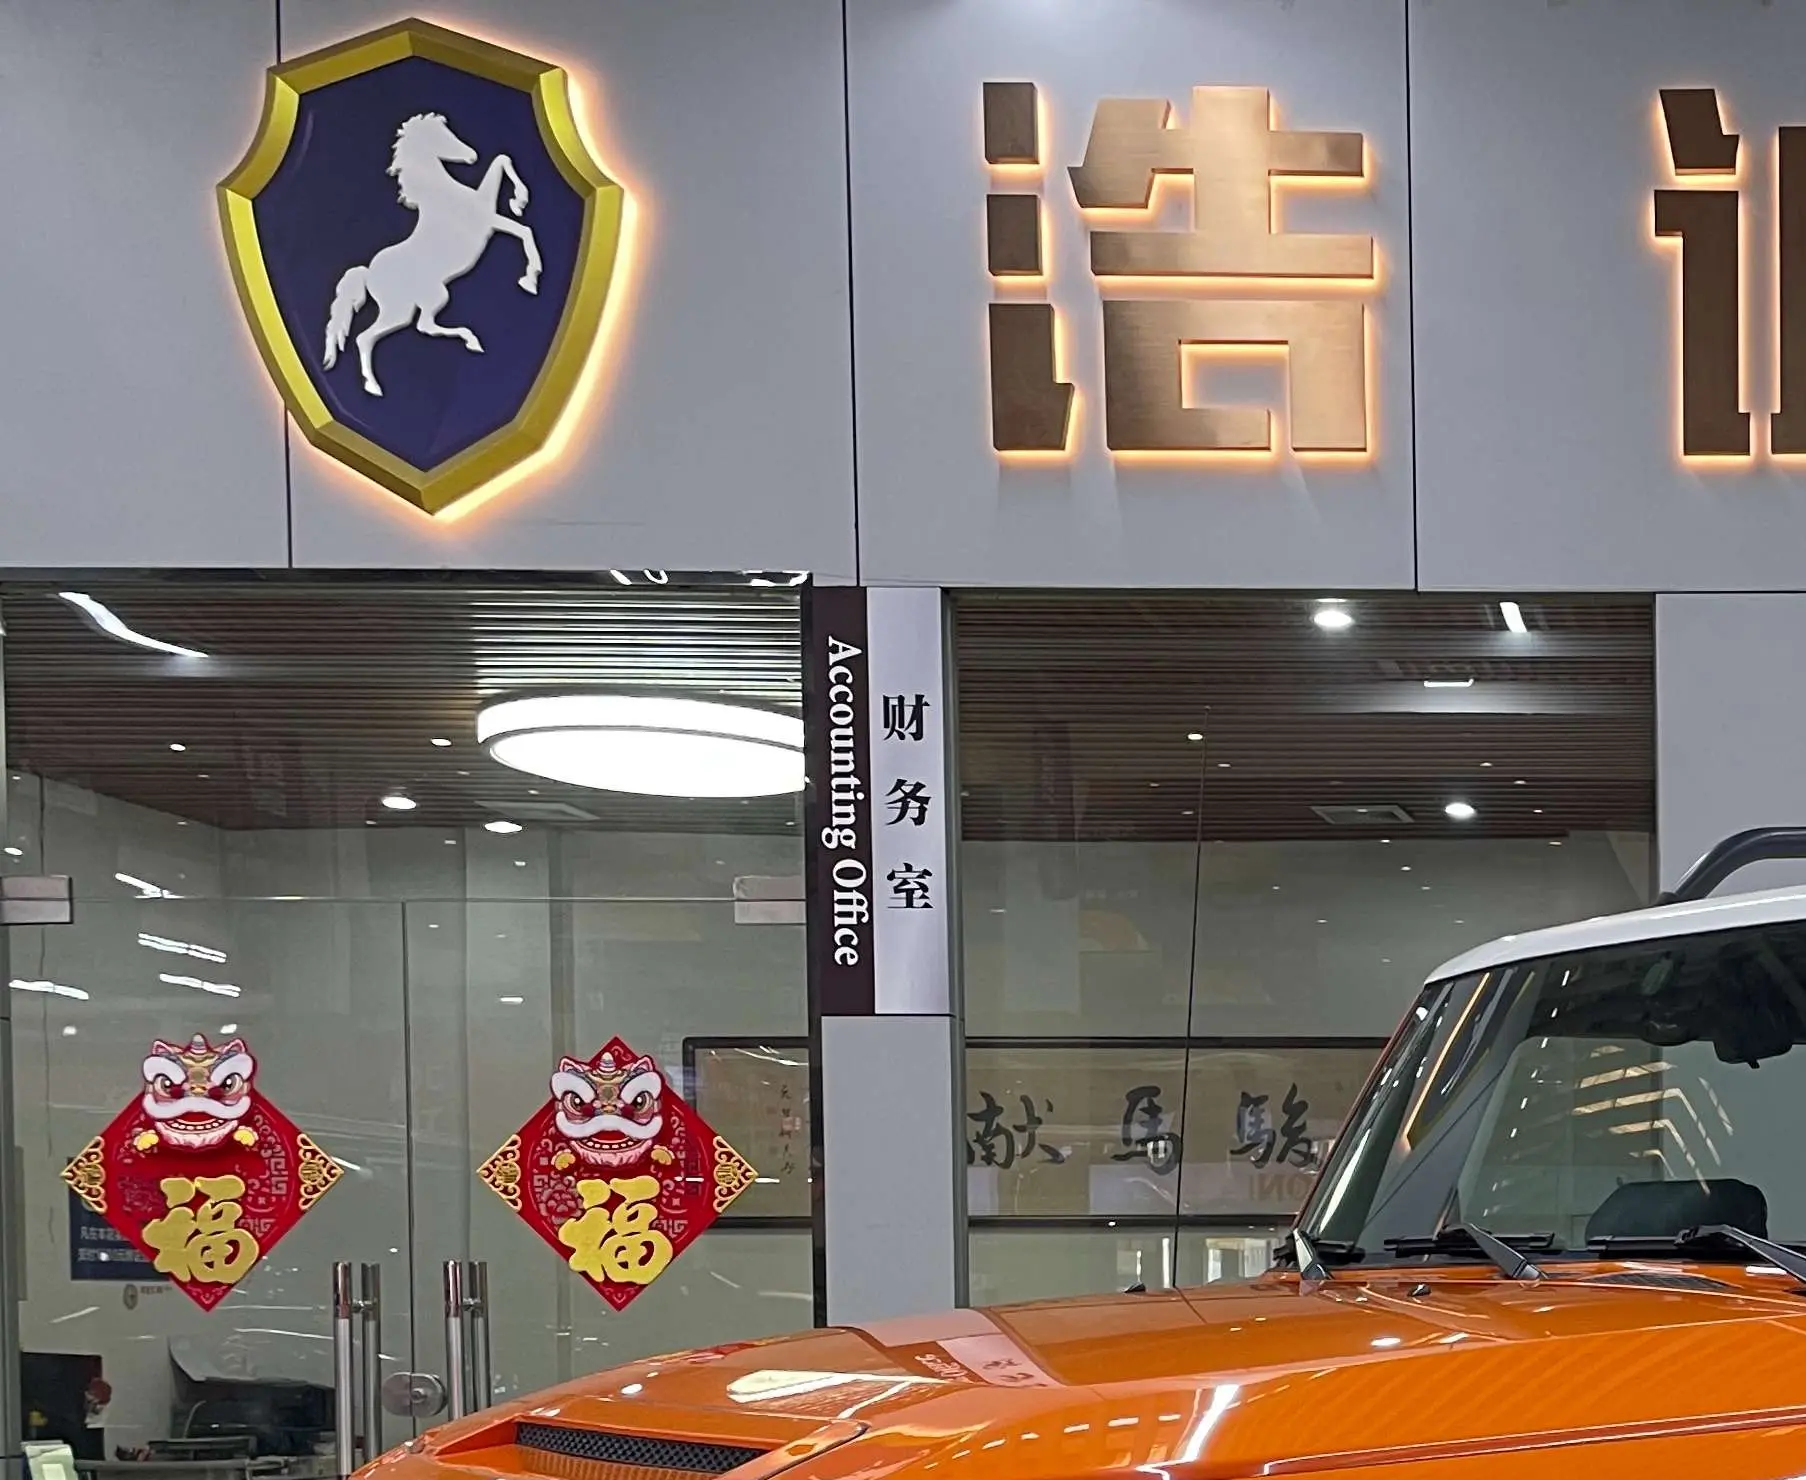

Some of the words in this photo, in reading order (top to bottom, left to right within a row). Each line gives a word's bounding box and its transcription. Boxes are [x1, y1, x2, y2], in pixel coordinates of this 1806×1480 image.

[820, 634, 866, 850] Accounting
[881, 693, 935, 910] 财务室
[831, 857, 870, 966] Office
[141, 1174, 260, 1285] 福
[558, 1174, 674, 1285] 福
